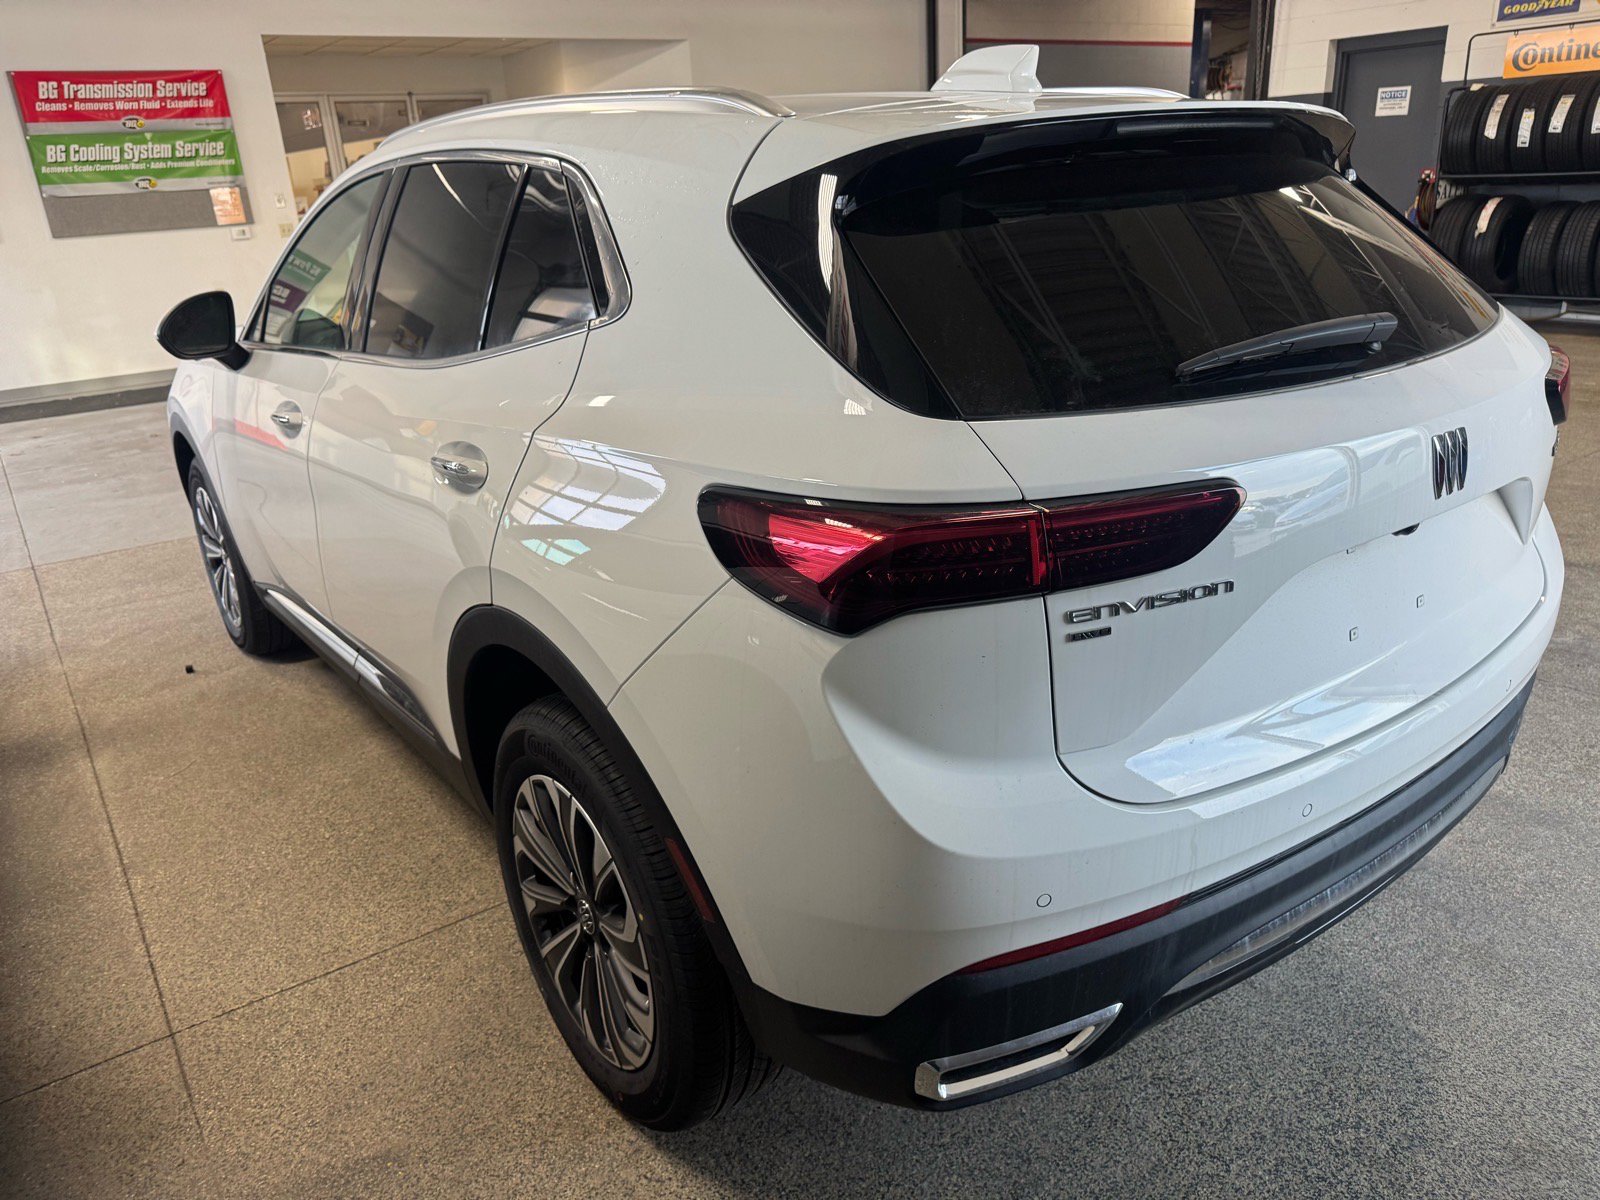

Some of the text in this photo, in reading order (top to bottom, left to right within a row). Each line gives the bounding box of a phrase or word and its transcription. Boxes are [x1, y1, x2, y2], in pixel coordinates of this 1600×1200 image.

[1504, 0, 1575, 15] GOODYEAR
[38, 79, 207, 99] BG Transmission Service
[1380, 91, 1407, 99] NOTICE
[35, 101, 67, 111] Cleans
[74, 100, 114, 111] Removes
[115, 99, 139, 110] Worn
[140, 99, 161, 109] Fluid
[166, 98, 198, 108] Extends
[46, 139, 225, 163] BG Cooling System Service
[41, 165, 72, 173] Removes
